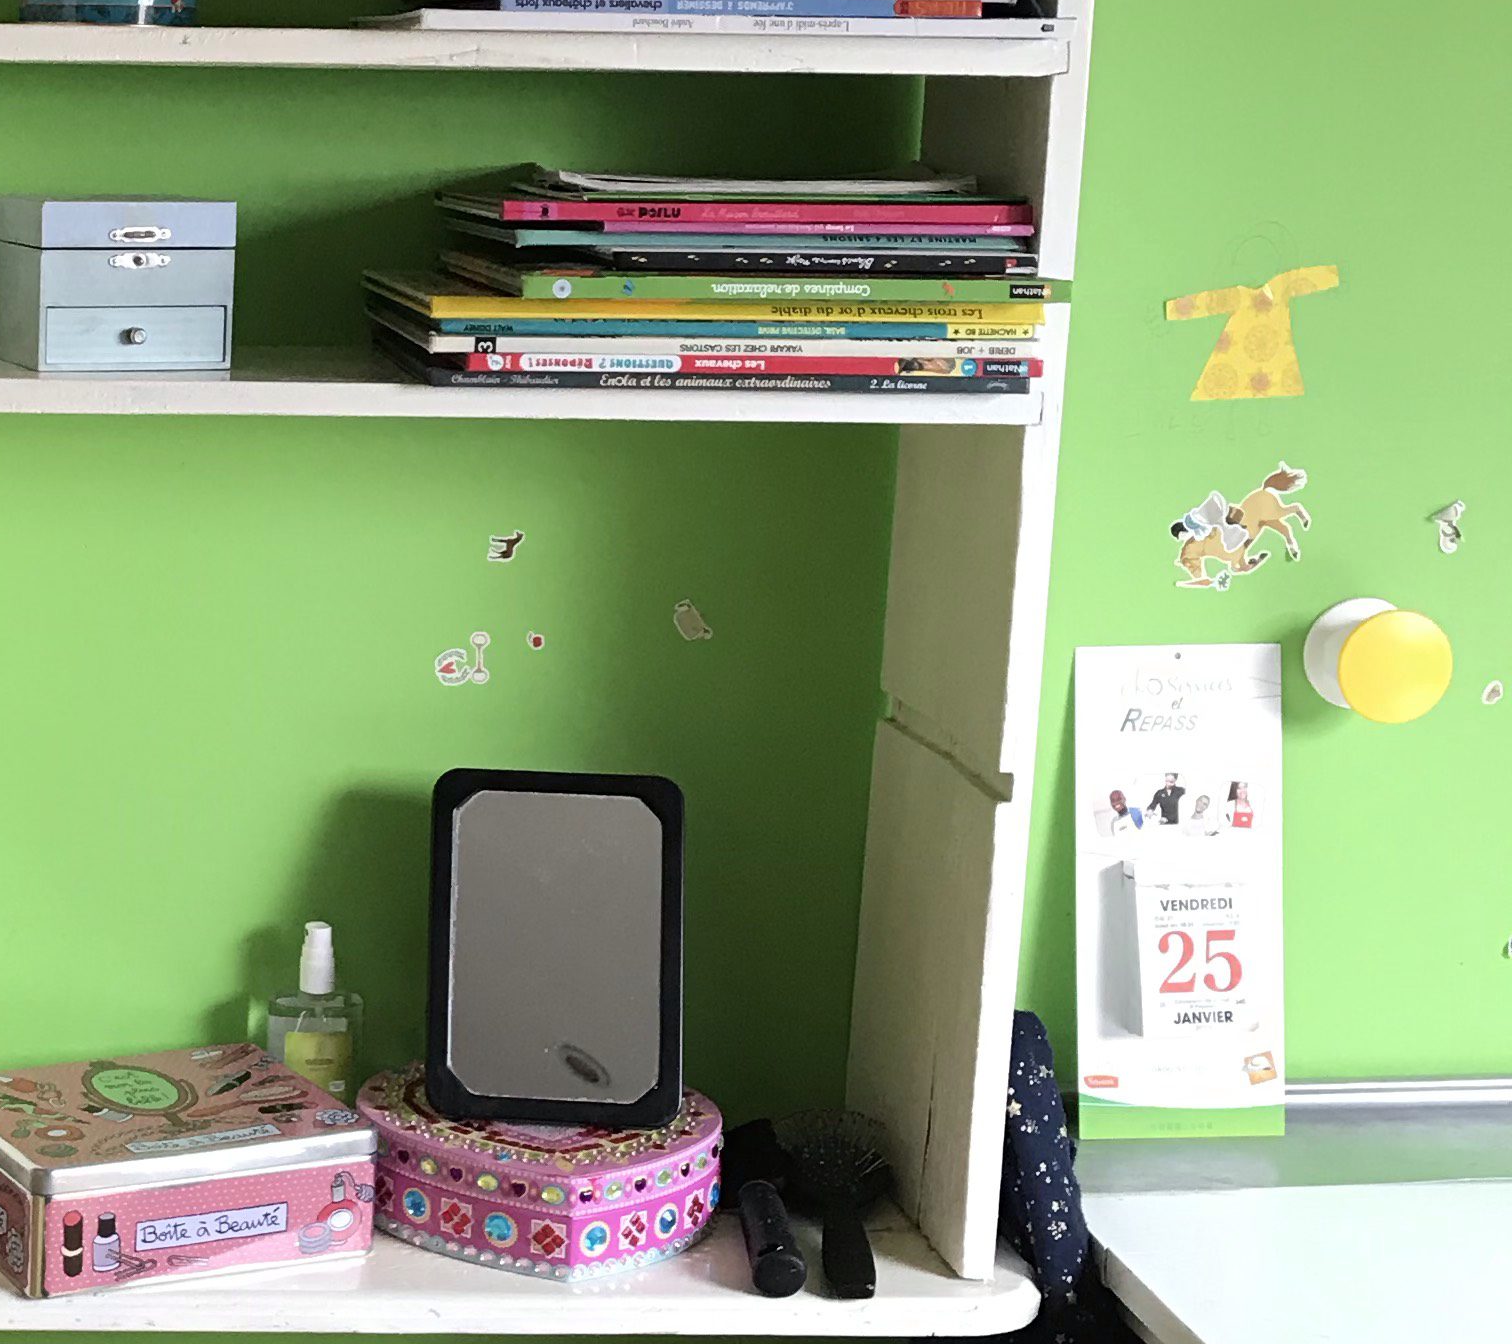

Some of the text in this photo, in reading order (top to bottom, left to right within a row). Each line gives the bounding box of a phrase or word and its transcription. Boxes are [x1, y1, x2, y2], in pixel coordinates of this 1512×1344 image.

[632, 17, 694, 29] André Bouchard
[752, 18, 768, 30] fée
[710, 281, 871, 297] Comptines de relaxation
[1011, 287, 1044, 298] Nathan
[770, 305, 983, 320] Les trois cheveux d'or du diable
[491, 323, 514, 333] WALT
[973, 327, 1017, 337] HACHETTE
[476, 339, 493, 353] 3
[679, 342, 724, 353] CASTORS
[724, 343, 742, 353] LES
[743, 343, 768, 353] CHEZ
[955, 345, 976, 355] JOB
[988, 345, 1016, 356] DERIB
[535, 356, 594, 369] RÉPONSES
[609, 357, 674, 369] QUESTIONS
[694, 358, 766, 370] Les chevaux
[986, 363, 1023, 374] Nathan
[599, 373, 832, 390] Enola et les animaux extraordinaires
[880, 378, 896, 390] La
[896, 378, 928, 391] licorne
[1159, 897, 1234, 913] VENDREDI
[1157, 929, 1244, 995] 25
[1173, 1010, 1235, 1025] JANVIER
[139, 1206, 282, 1244] Boîte à Beauté
